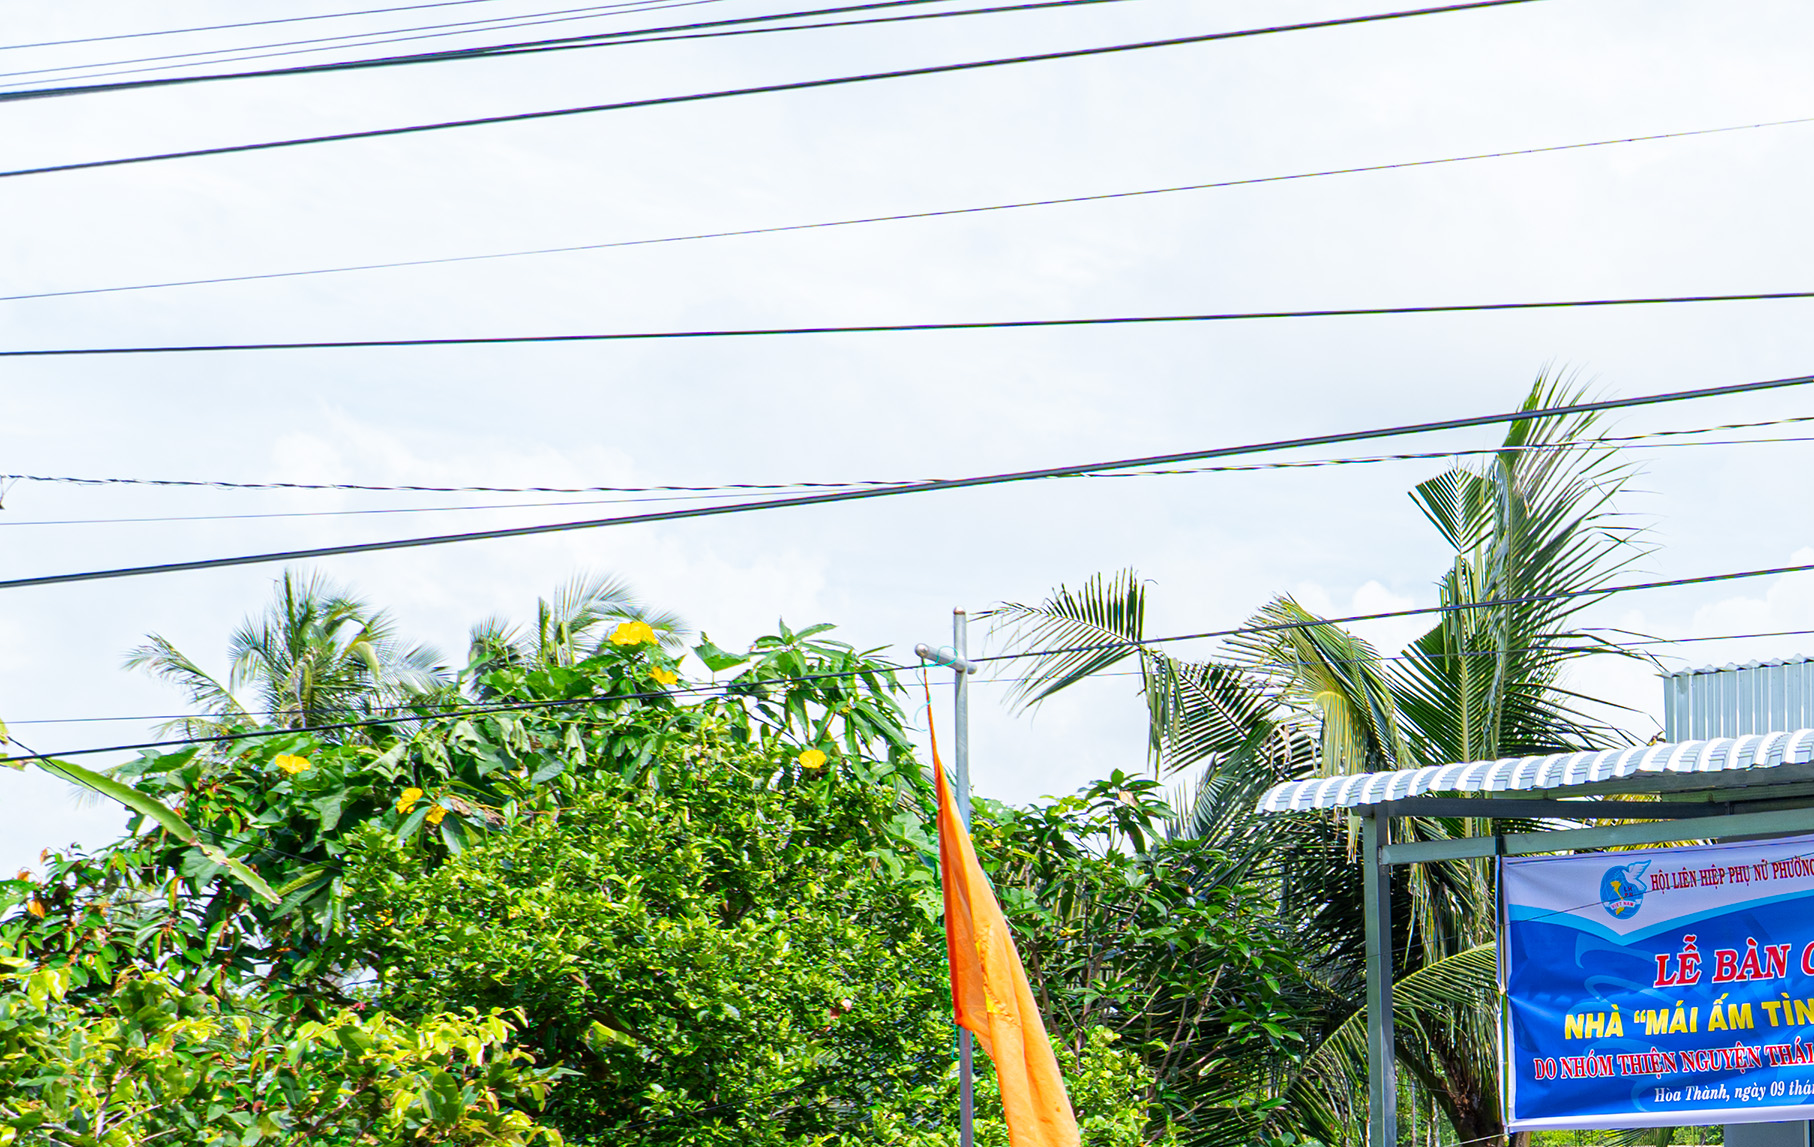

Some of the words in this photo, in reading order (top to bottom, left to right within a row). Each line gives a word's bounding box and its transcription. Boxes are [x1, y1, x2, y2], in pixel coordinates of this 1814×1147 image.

[1650, 869, 1670, 894] HỘI
[1672, 867, 1697, 889] LIÊN
[1699, 864, 1725, 889] HIỆP
[1729, 864, 1750, 886] PHỤ
[1753, 859, 1769, 881] NỮ
[1653, 934, 1702, 988] LỄ
[1712, 937, 1791, 984] BÀN
[1565, 1004, 1624, 1040] NHÀ
[1708, 993, 1754, 1032] ẤM
[1533, 1056, 1557, 1080] DO
[1560, 1049, 1615, 1079] NHÓM
[1617, 1047, 1677, 1079] THIỆN
[1679, 1041, 1762, 1074] NGUYỆN
[1764, 1036, 1814, 1067] THÁI
[1654, 1087, 1682, 1103] Hòa
[1685, 1084, 1731, 1102] Thành,
[1734, 1082, 1767, 1101] ngày
[1770, 1081, 1785, 1097] 09
